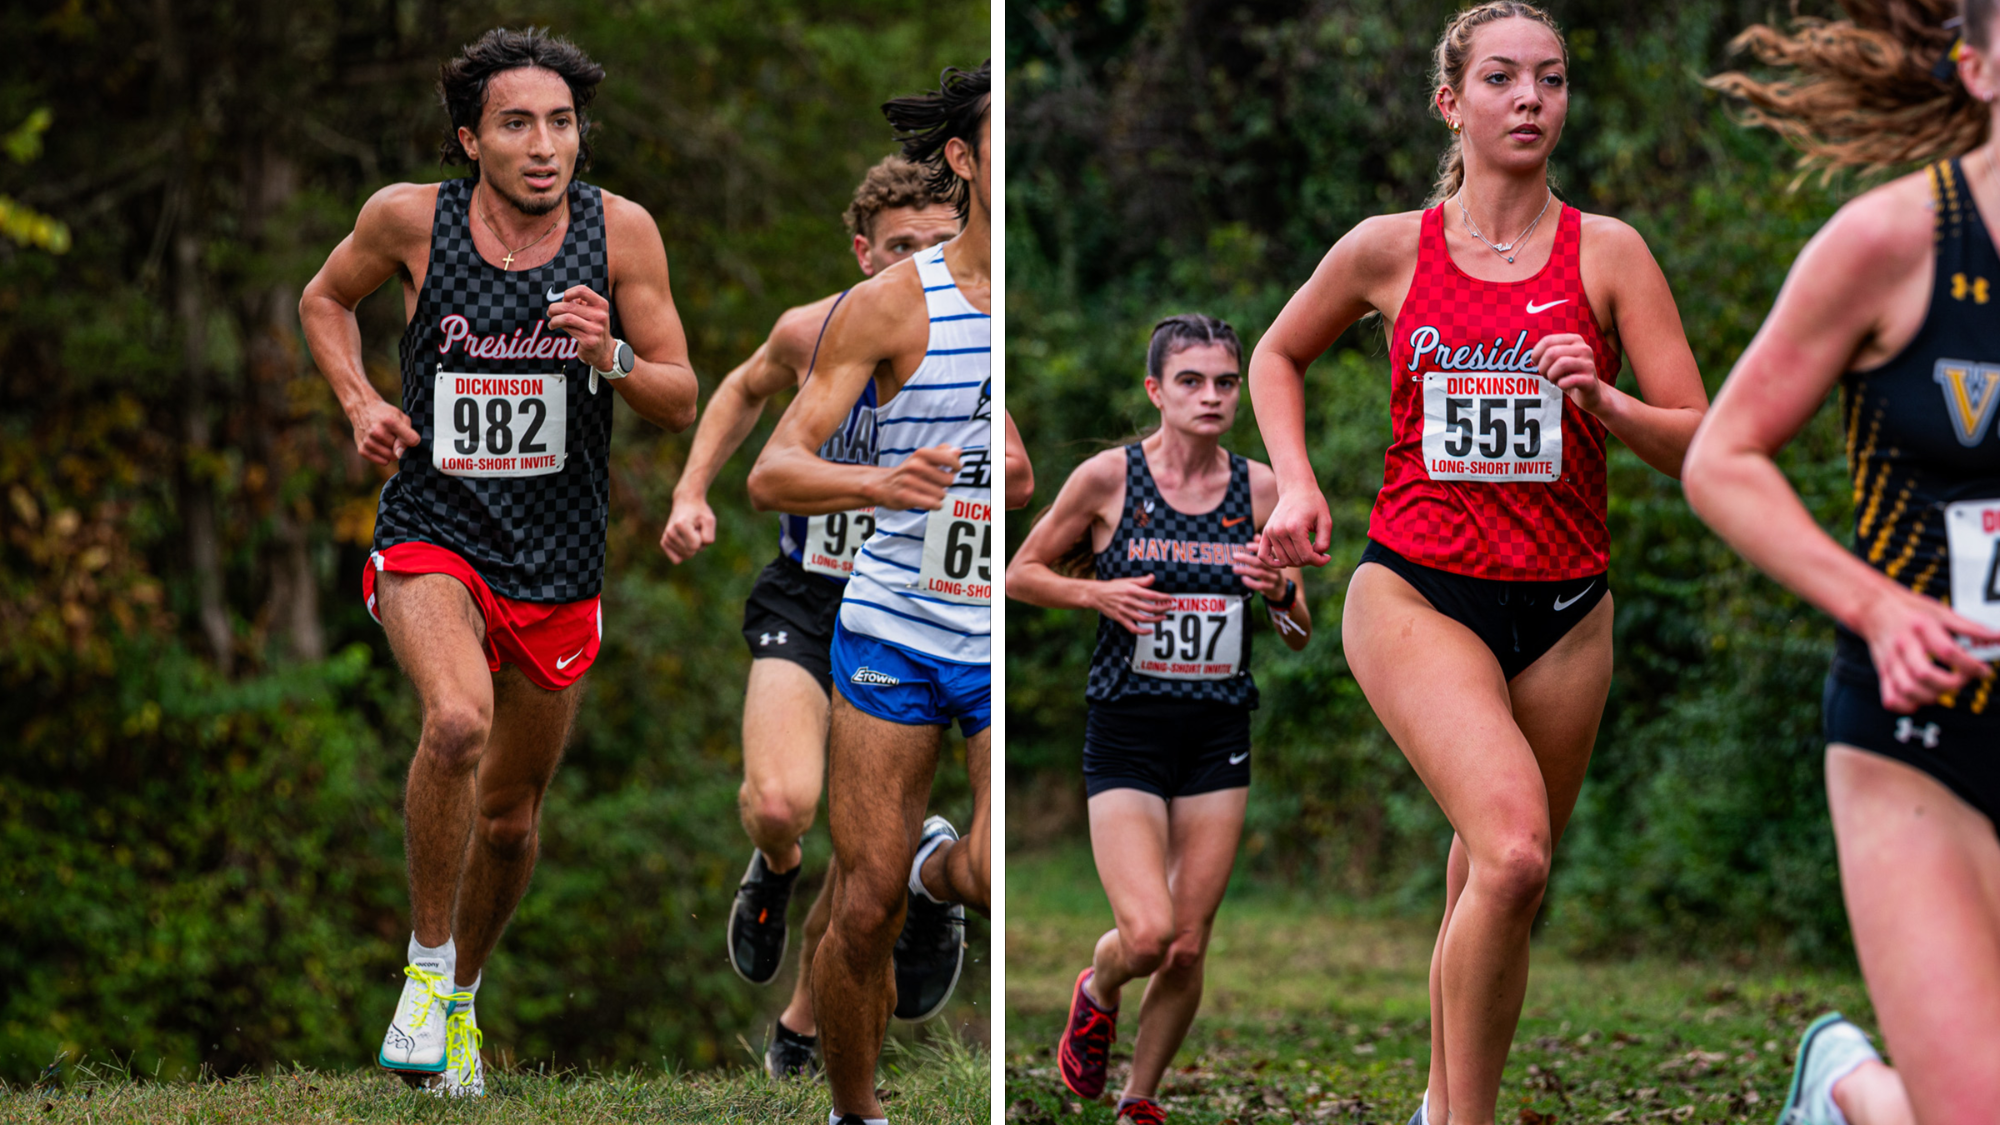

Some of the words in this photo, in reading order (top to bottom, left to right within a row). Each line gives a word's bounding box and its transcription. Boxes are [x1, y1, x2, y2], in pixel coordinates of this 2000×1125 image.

[456, 378, 543, 395] DICKINSON
[1446, 377, 1540, 396] DICKINSON
[453, 397, 547, 456] 982
[1444, 397, 1542, 459] 555
[442, 457, 517, 471] LONG-SHORT
[520, 455, 556, 469] INVITE
[1431, 459, 1511, 475] LONG-SHORT
[1513, 461, 1553, 475] INVITE
[1153, 613, 1228, 661] 597
[1141, 660, 1202, 673] LONG-SHORT
[1203, 664, 1232, 674] INVITE
